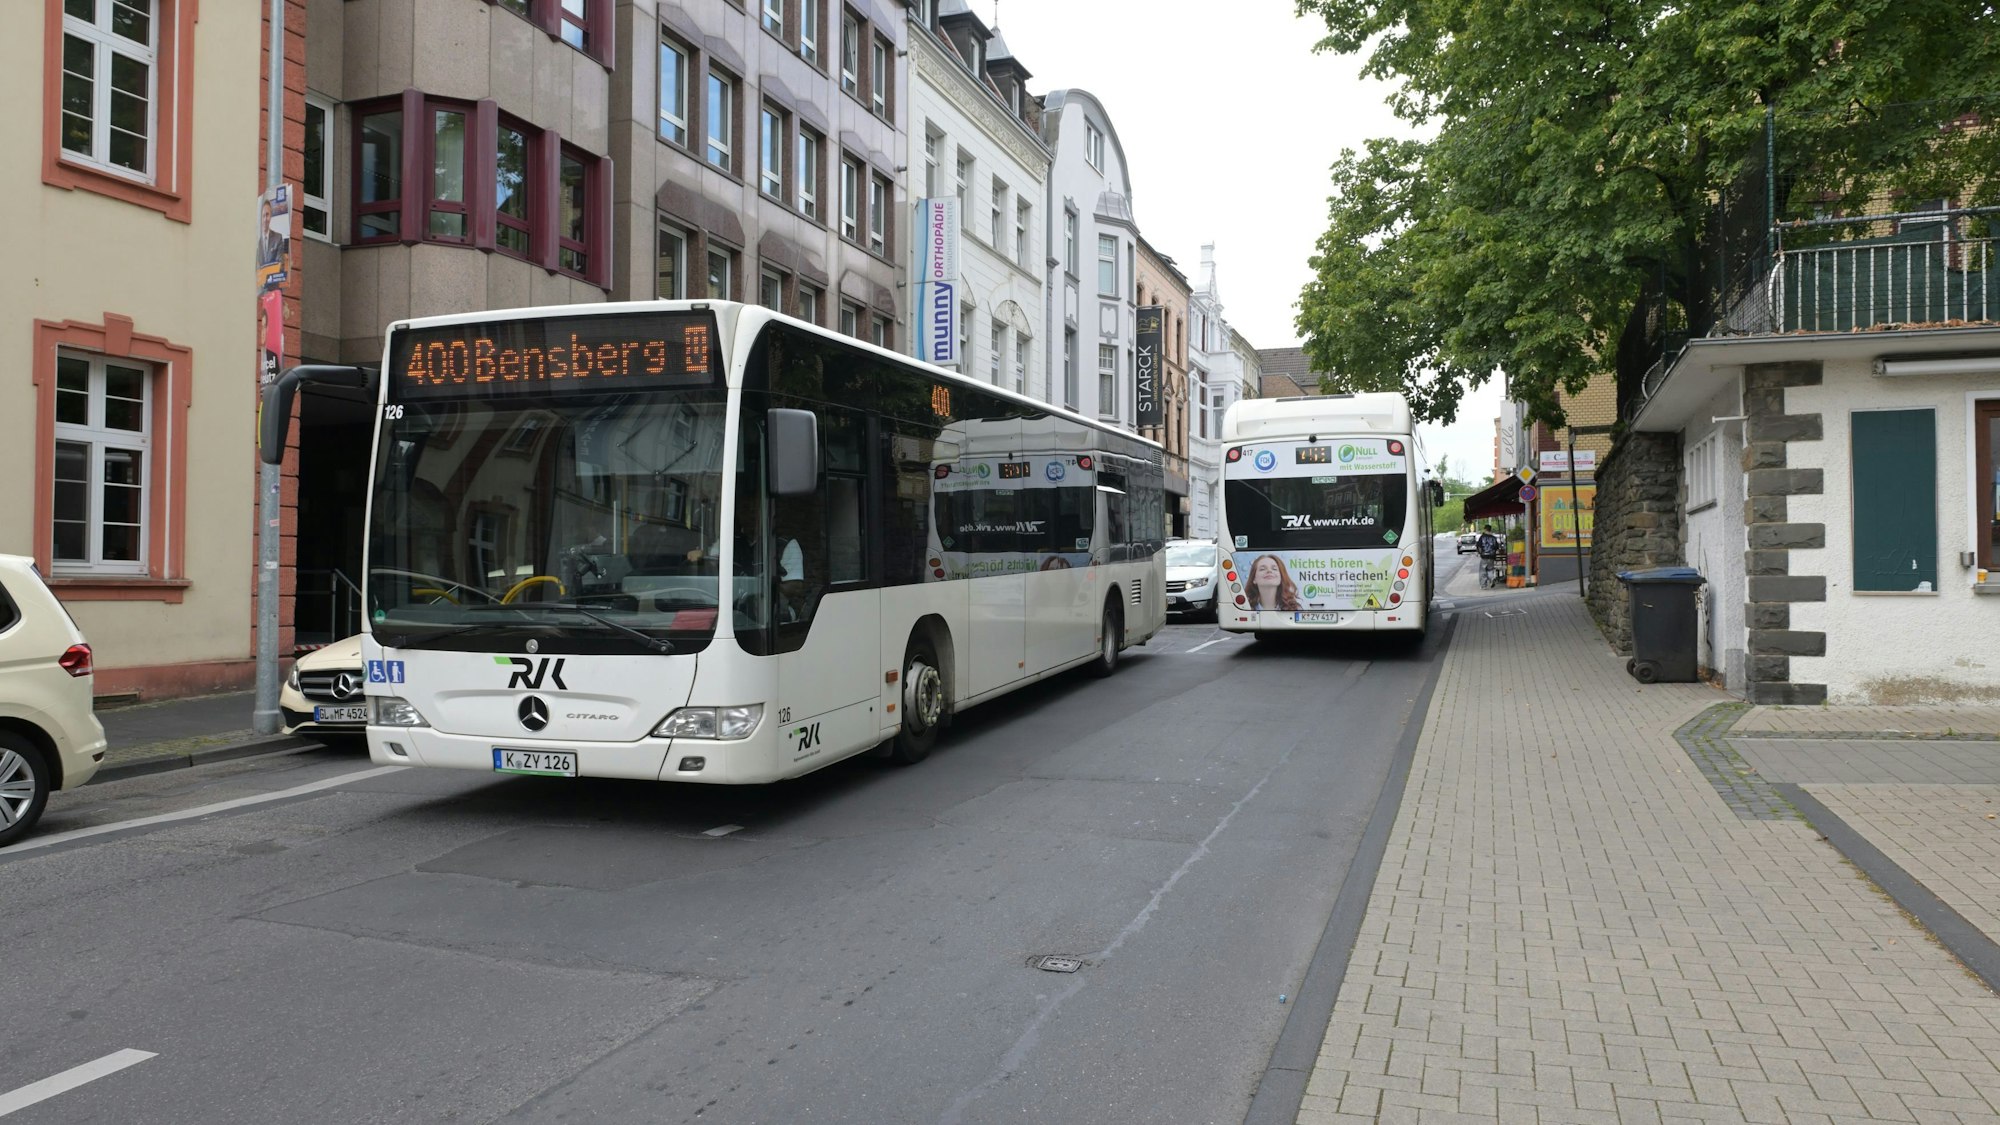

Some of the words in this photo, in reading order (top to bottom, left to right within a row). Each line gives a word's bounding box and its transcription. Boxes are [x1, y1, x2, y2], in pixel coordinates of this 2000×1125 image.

[933, 202, 944, 278] ORTHOPÄDIE
[934, 281, 952, 360] munny
[407, 342, 468, 384] 400
[475, 333, 665, 382] Bensberg
[1138, 345, 1151, 411] STARCK
[931, 384, 950, 417] 400
[384, 405, 404, 420] 126
[1354, 462, 1396, 470] Wasserstoff
[1313, 516, 1375, 527] www.rvk.de
[1290, 559, 1325, 569] Nichts
[1330, 558, 1363, 568] hören
[1299, 571, 1335, 581] Nichts
[1340, 570, 1388, 580] riechen!
[319, 708, 329, 719] GL
[334, 708, 344, 719] MF
[346, 708, 367, 719] 4524
[566, 712, 620, 721] CITARO
[778, 706, 790, 724] 126
[506, 752, 515, 768] K
[524, 754, 540, 769] ZY
[544, 755, 570, 771] 126
